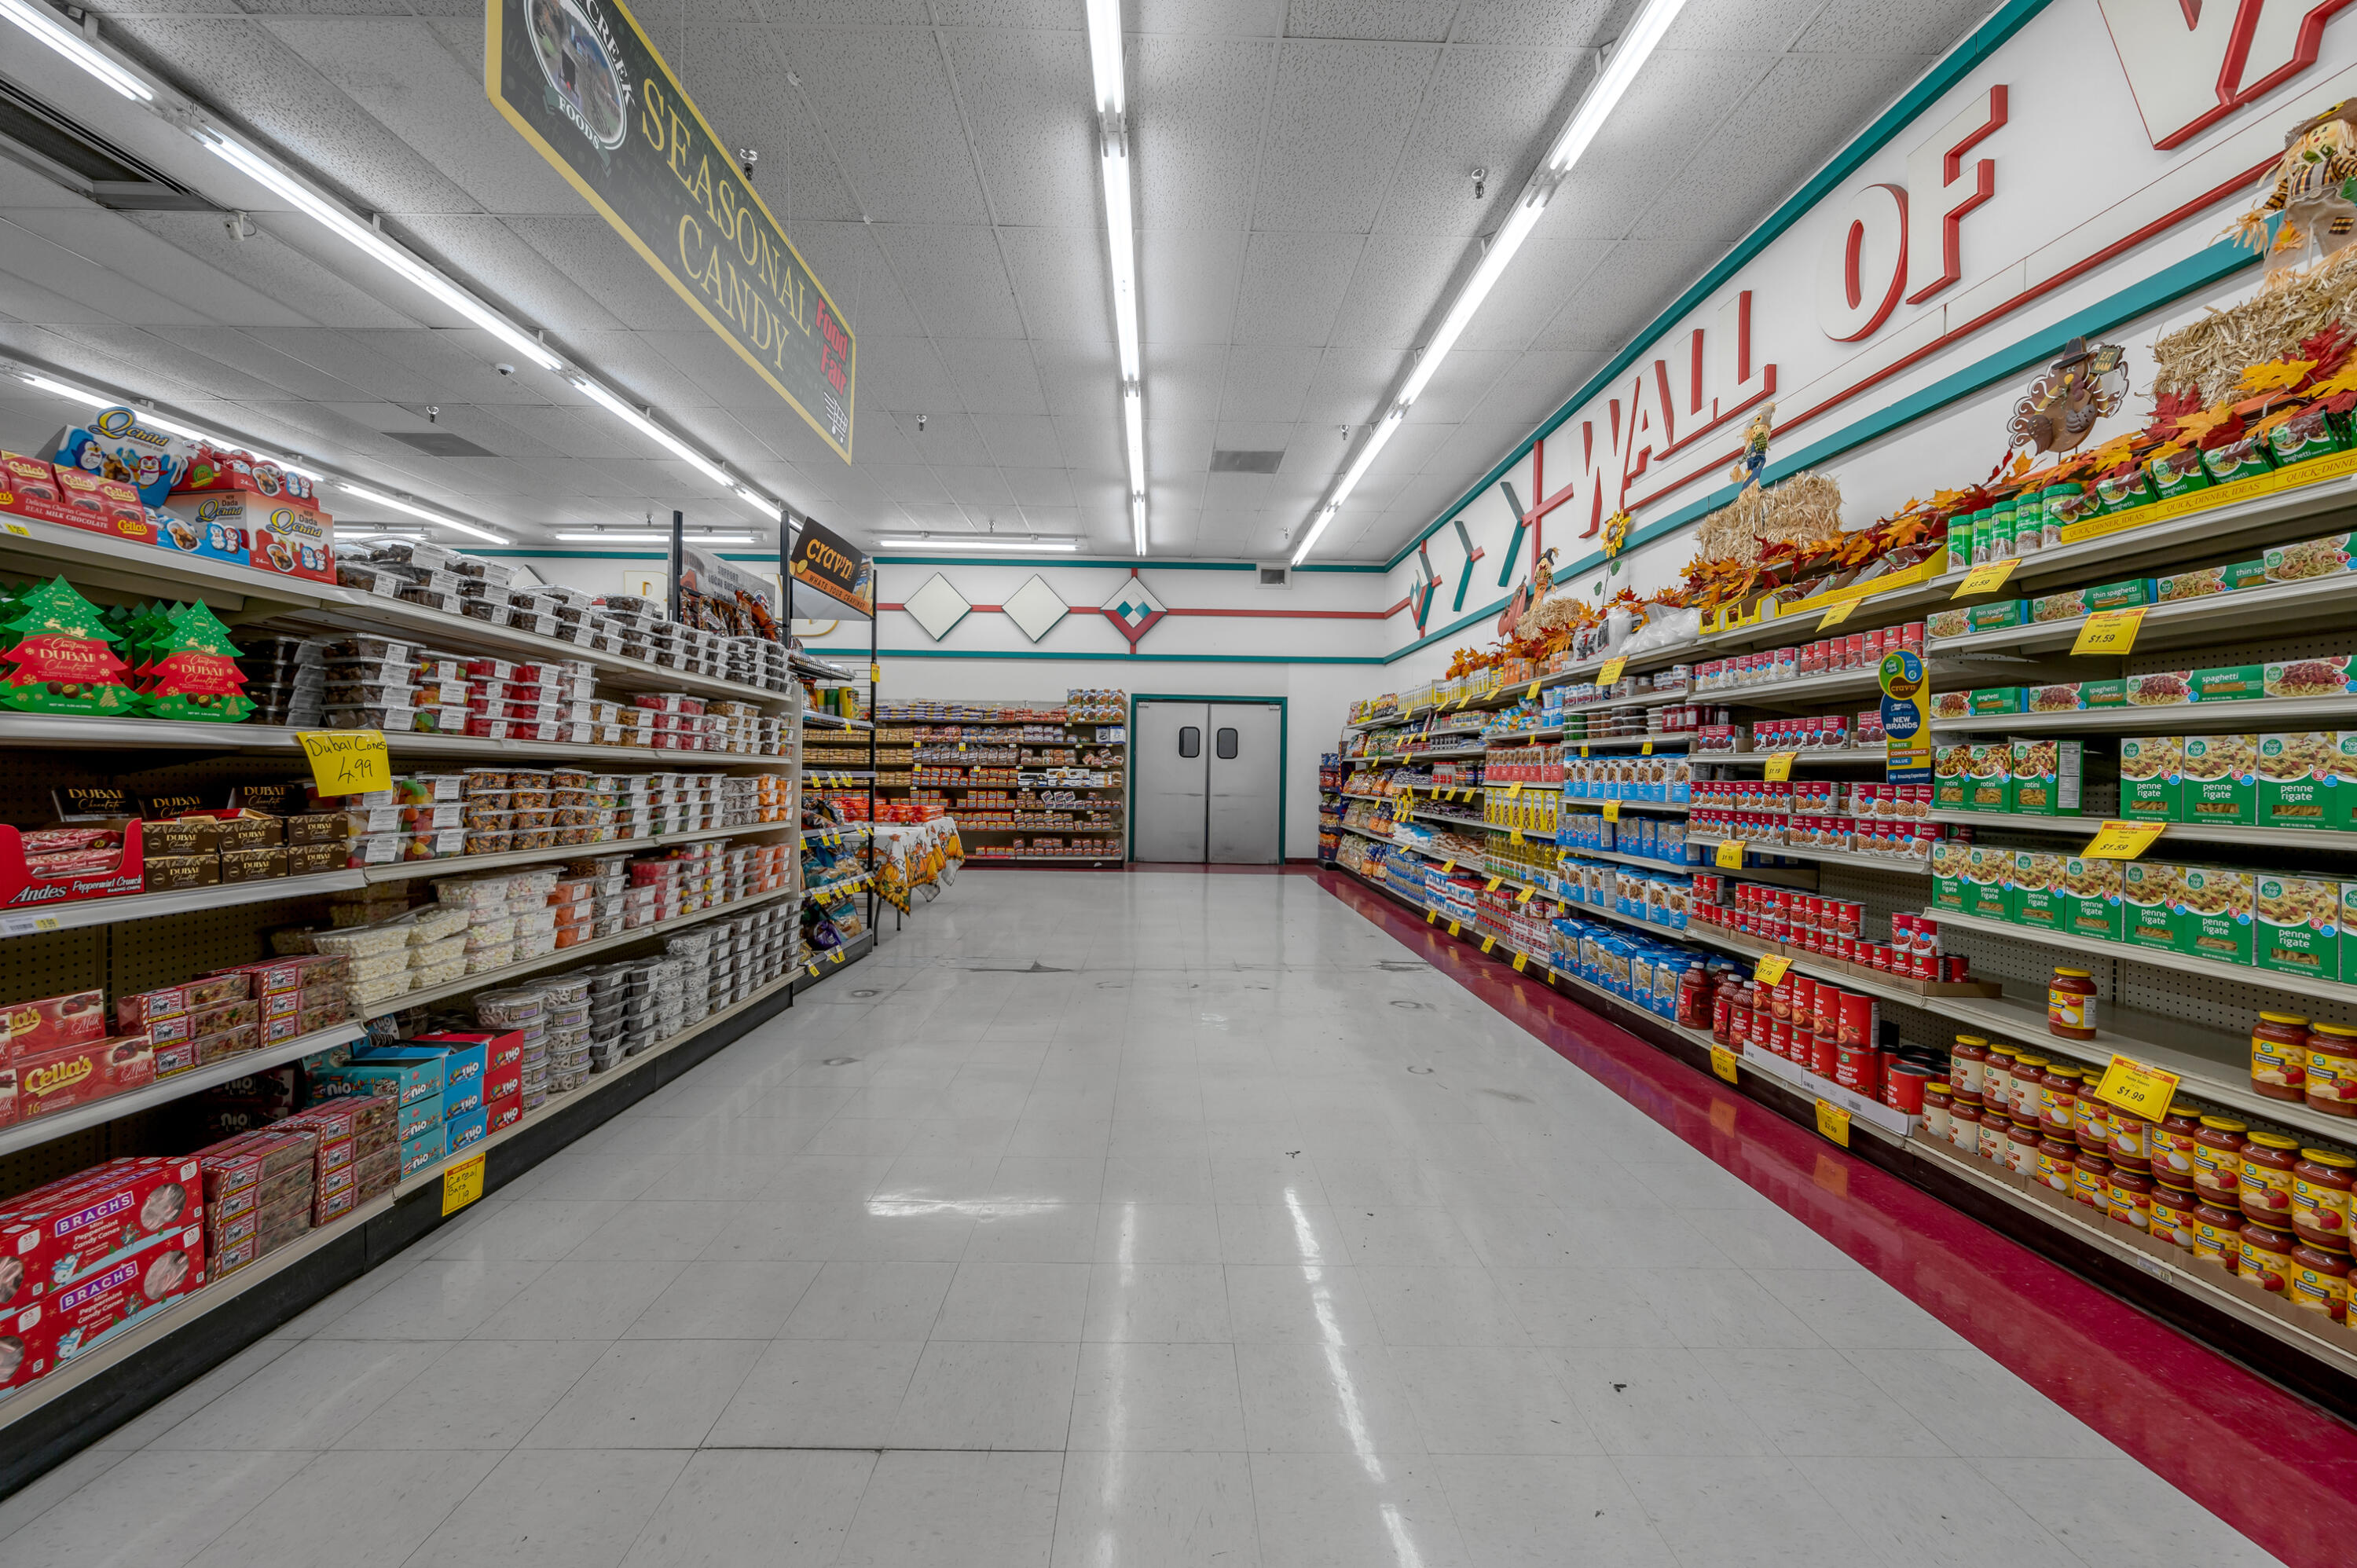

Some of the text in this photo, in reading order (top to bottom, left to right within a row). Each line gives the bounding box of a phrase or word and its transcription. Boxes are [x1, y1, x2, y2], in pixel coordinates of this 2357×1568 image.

[559, 95, 599, 149] FOODS
[642, 78, 810, 337] SEASONAL
[680, 214, 789, 372] CANDY
[1571, 84, 2010, 537] WALL OF
[816, 298, 849, 362] Food
[2099, 351, 2114, 361] EAT
[820, 346, 847, 394] Fair
[2094, 362, 2112, 372] HAM
[2282, 451, 2311, 463] spaghetti
[9, 461, 46, 476] Cella's
[2286, 457, 2357, 482] QUICK-DINNE
[63, 474, 95, 489] Cella's
[104, 485, 136, 500] Cella's
[2161, 485, 2187, 497] spaghetti
[2167, 482, 2260, 512] QUICK-DINNER IDEAS
[222, 499, 238, 507] Dada
[25, 505, 108, 529] REAL MILK CHOCOLATE
[299, 514, 317, 526] Dada
[118, 519, 148, 533] Cella's
[2069, 512, 2145, 538] QUICK-DINNER IDEAS
[806, 538, 854, 580] crav'n
[717, 565, 739, 581] SUPPORT
[2236, 568, 2249, 577] thin
[809, 575, 827, 590] WHATS
[829, 584, 842, 599] YOUR
[2107, 585, 2138, 599] spaghetti
[1987, 605, 2011, 617] spaghetti
[2088, 634, 2115, 643] $1.59
[39, 649, 95, 663] DUBAI
[181, 664, 224, 676] DUBAI
[2202, 672, 2238, 684] spaghetti
[2089, 684, 2117, 694] spaghetti
[1977, 693, 1999, 702] spaghetti
[1886, 721, 1918, 730] BRANDS
[306, 735, 387, 757] Dubai Cones
[337, 757, 372, 784] 4.99
[68, 788, 126, 799] DUBAI
[244, 786, 286, 796] DUBAI
[2137, 783, 2162, 792] penne
[2137, 789, 2161, 798] rigate
[2203, 783, 2232, 793] penne
[2280, 785, 2314, 795] penne
[2203, 790, 2231, 800] rigate
[2281, 792, 2313, 802] rigate
[153, 796, 200, 808] DUBAI
[308, 822, 331, 831] DUBAI
[167, 833, 196, 842] DUBAI
[239, 831, 266, 840] DUBAI
[308, 852, 331, 861] DUBAI
[170, 866, 200, 877] DUBAI
[244, 861, 270, 870] DUBAI
[72, 874, 142, 894] Peppermint Crunch
[9, 885, 67, 903] Andes
[1981, 886, 1999, 895] penne
[1981, 892, 1999, 900] rigate
[2028, 892, 2049, 901] penne
[2081, 900, 2103, 910] penne
[2081, 907, 2103, 916] rigate
[2141, 908, 2167, 918] penne
[2142, 915, 2166, 925] rigate
[2202, 918, 2230, 928] penne
[2202, 925, 2229, 936] rigate
[2278, 929, 2311, 940] penne
[2279, 936, 2310, 948] rigate
[1836, 1062, 1858, 1073] tomato
[24, 1055, 93, 1093] Cella's
[327, 1079, 351, 1096] nio
[413, 1083, 427, 1097] nio
[2117, 1086, 2145, 1102] $1.99
[26, 1102, 40, 1116] 16
[411, 1120, 427, 1135] nio
[412, 1152, 429, 1168] nio
[75, 1219, 119, 1241] Peppermint
[90, 1219, 104, 1230] Mini
[73, 1226, 120, 1251] Candy Canes
[93, 1291, 108, 1302] Mini
[79, 1291, 123, 1316] Peppermint
[78, 1298, 124, 1324] Candy Canes
